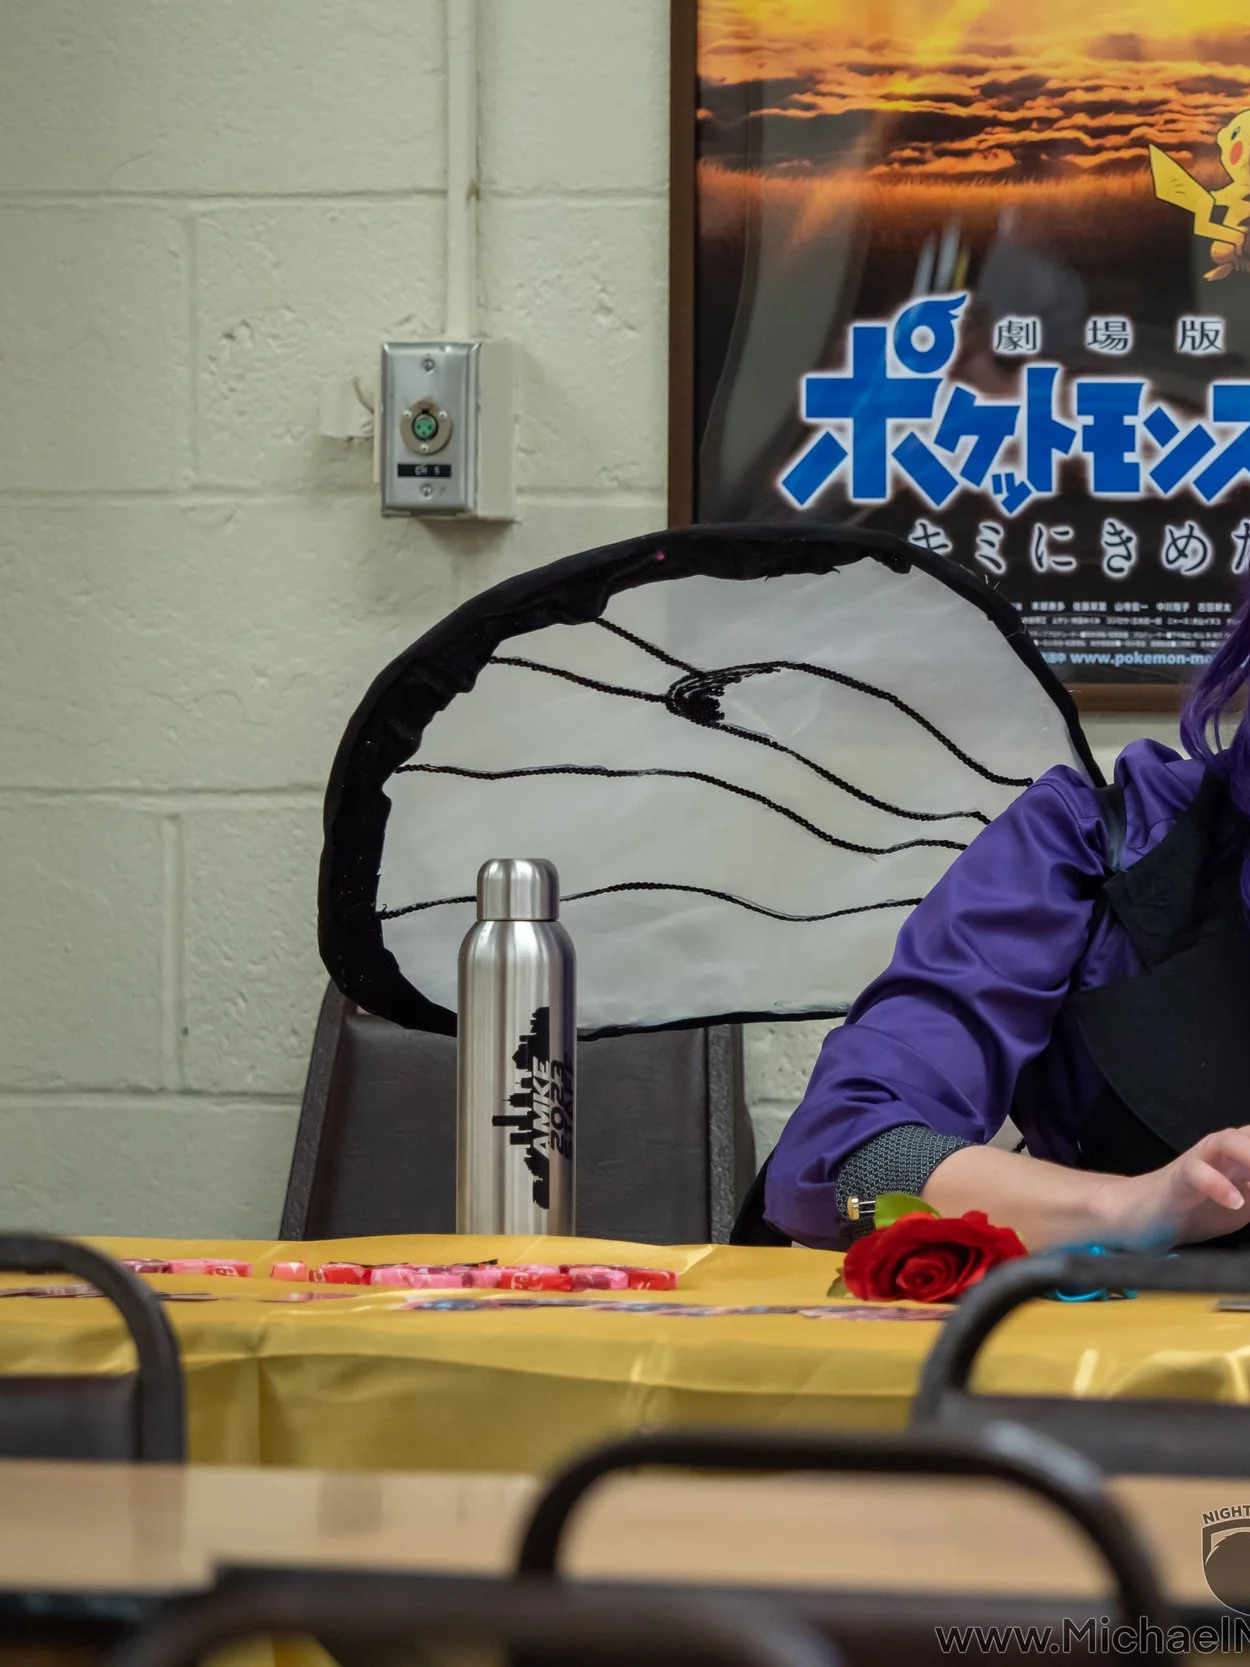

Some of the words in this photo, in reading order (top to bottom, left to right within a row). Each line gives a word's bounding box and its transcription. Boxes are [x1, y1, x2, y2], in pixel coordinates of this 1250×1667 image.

[995, 316, 1224, 353] 劇場版
[1070, 650, 1214, 667] www.pokemon-mo
[533, 1056, 550, 1159] AMKE
